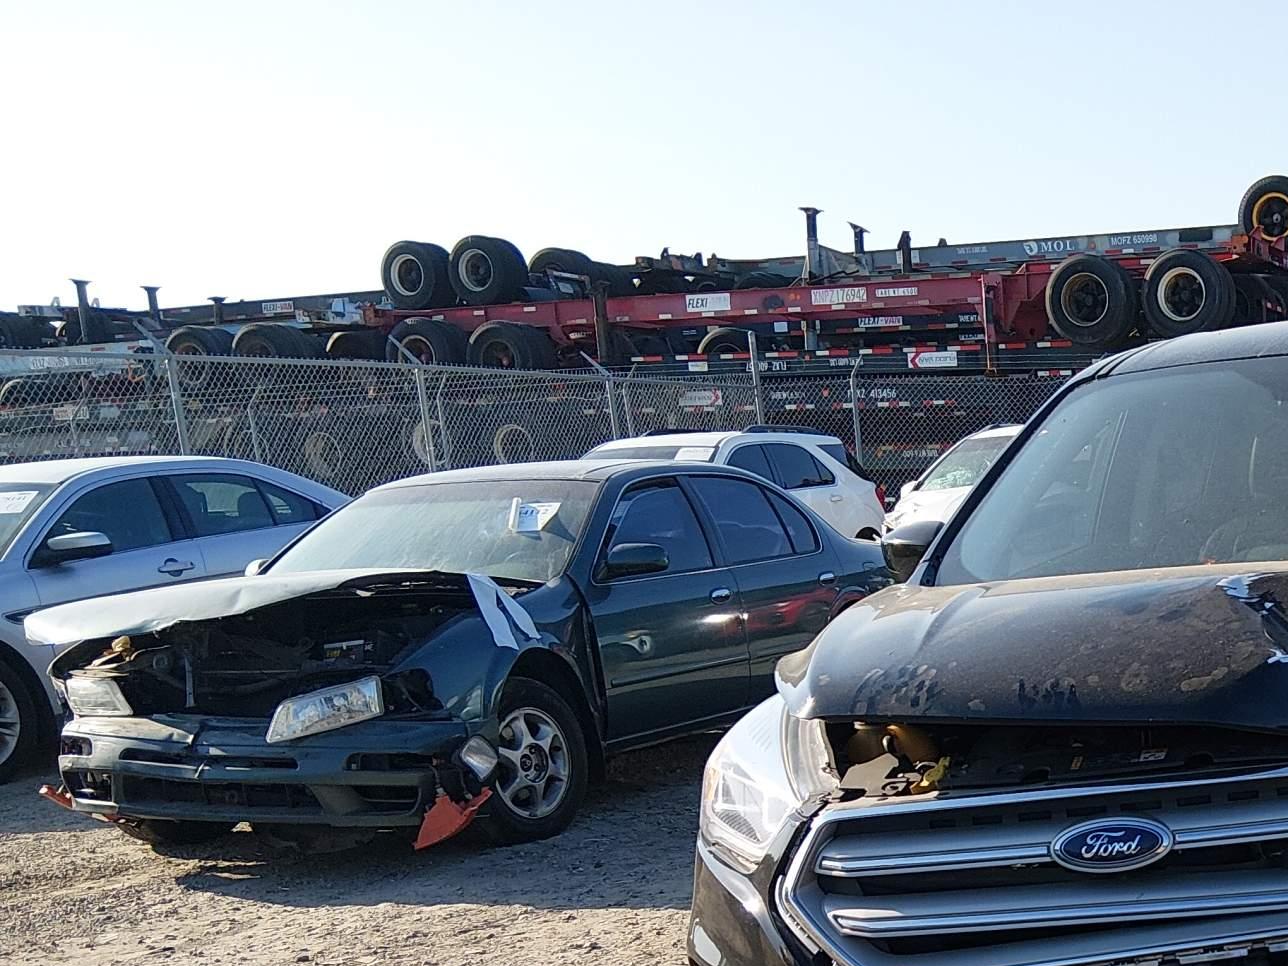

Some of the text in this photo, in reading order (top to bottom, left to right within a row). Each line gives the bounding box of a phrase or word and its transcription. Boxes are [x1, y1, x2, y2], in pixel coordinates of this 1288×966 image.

[1041, 239, 1075, 252] MOL
[1111, 236, 1131, 246] MOFZ
[688, 297, 708, 309] FLEXI
[1081, 830, 1142, 859] Ford
